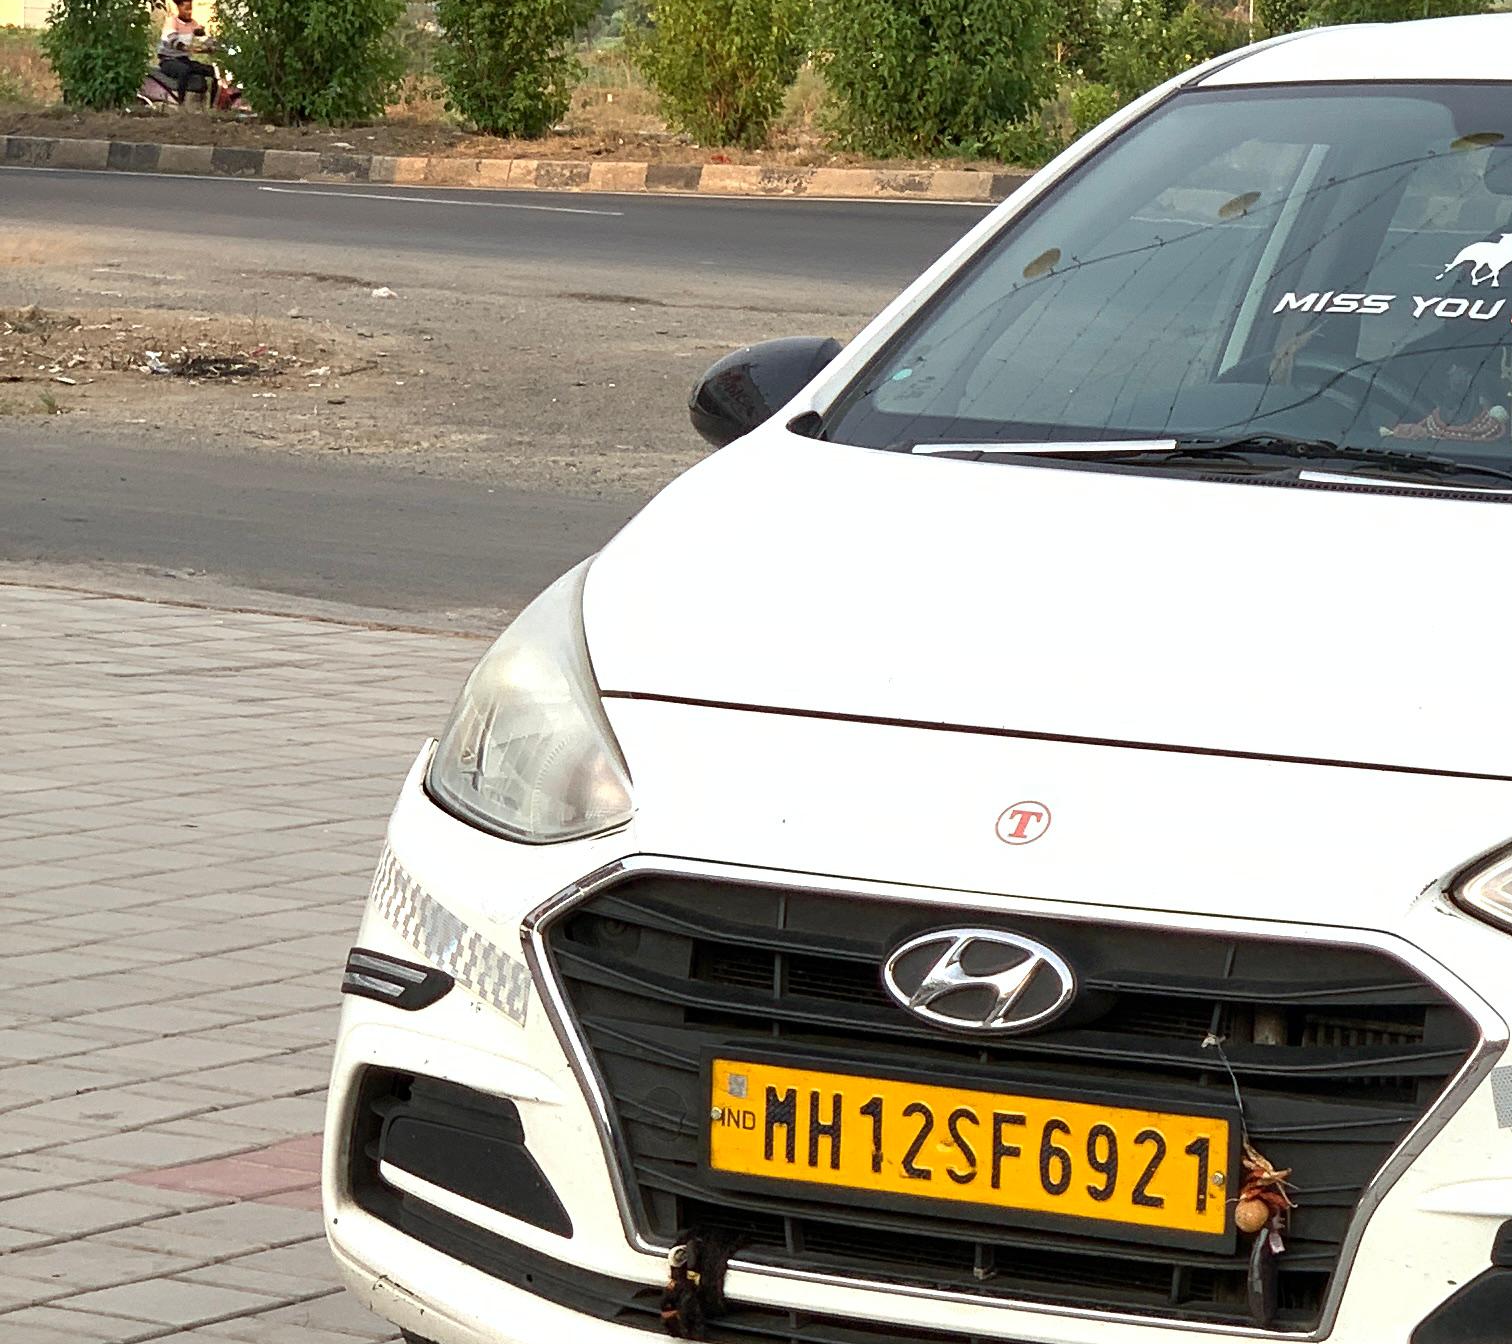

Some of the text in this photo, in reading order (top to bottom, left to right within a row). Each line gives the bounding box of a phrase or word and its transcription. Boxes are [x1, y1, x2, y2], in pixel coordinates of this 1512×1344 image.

[1273, 291, 1397, 316] MISS
[1410, 296, 1506, 321] YOU
[1008, 809, 1044, 838] T
[721, 1107, 756, 1131] IND
[764, 1085, 1211, 1215] MH12SF6921
